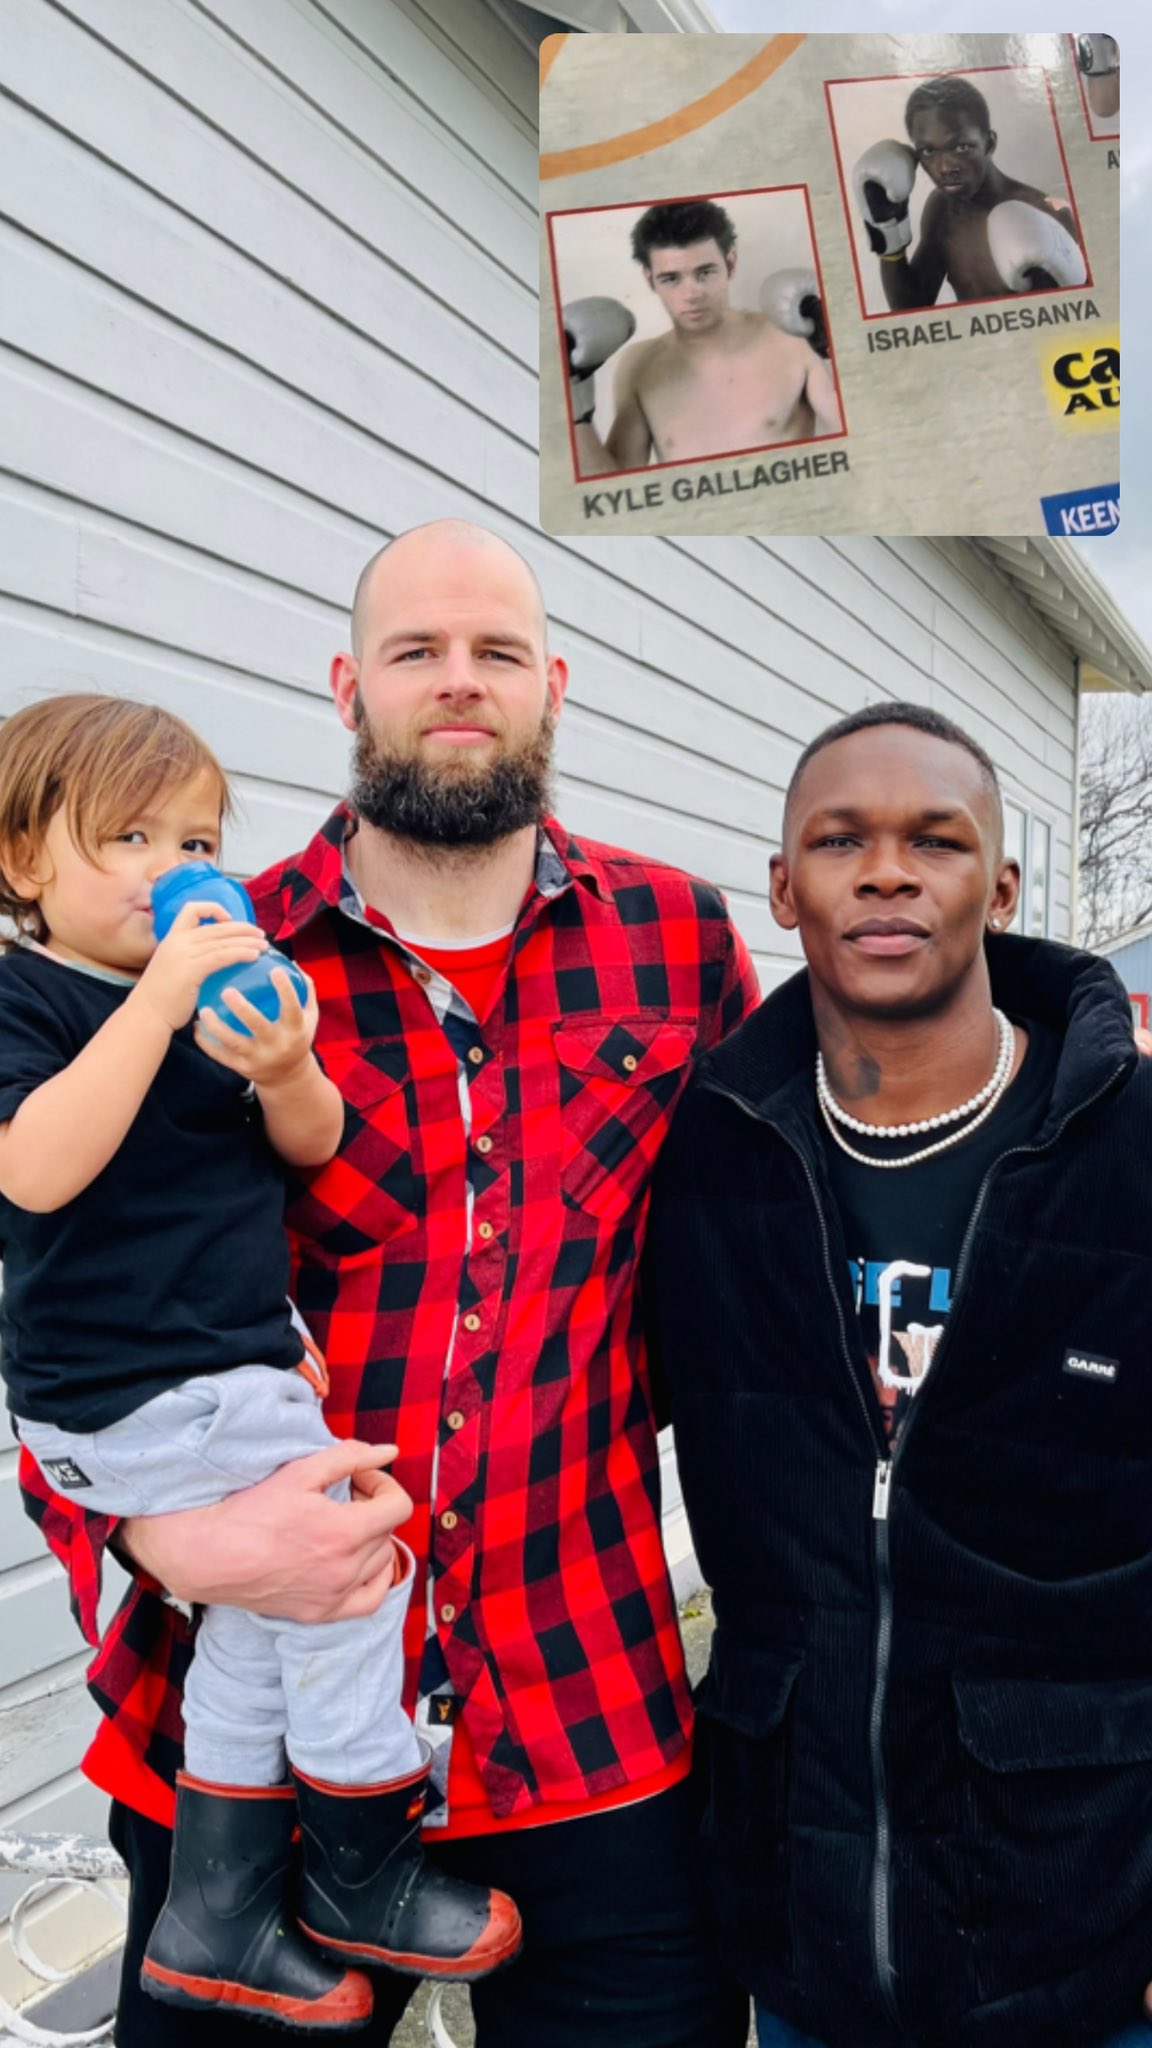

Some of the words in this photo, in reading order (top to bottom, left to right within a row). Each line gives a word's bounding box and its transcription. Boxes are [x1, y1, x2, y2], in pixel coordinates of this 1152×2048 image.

[867, 320, 962, 353] ISRAEL
[969, 299, 1100, 337] ADESANYA
[583, 482, 664, 519] KYLE
[672, 450, 850, 502] GALLAGHER
